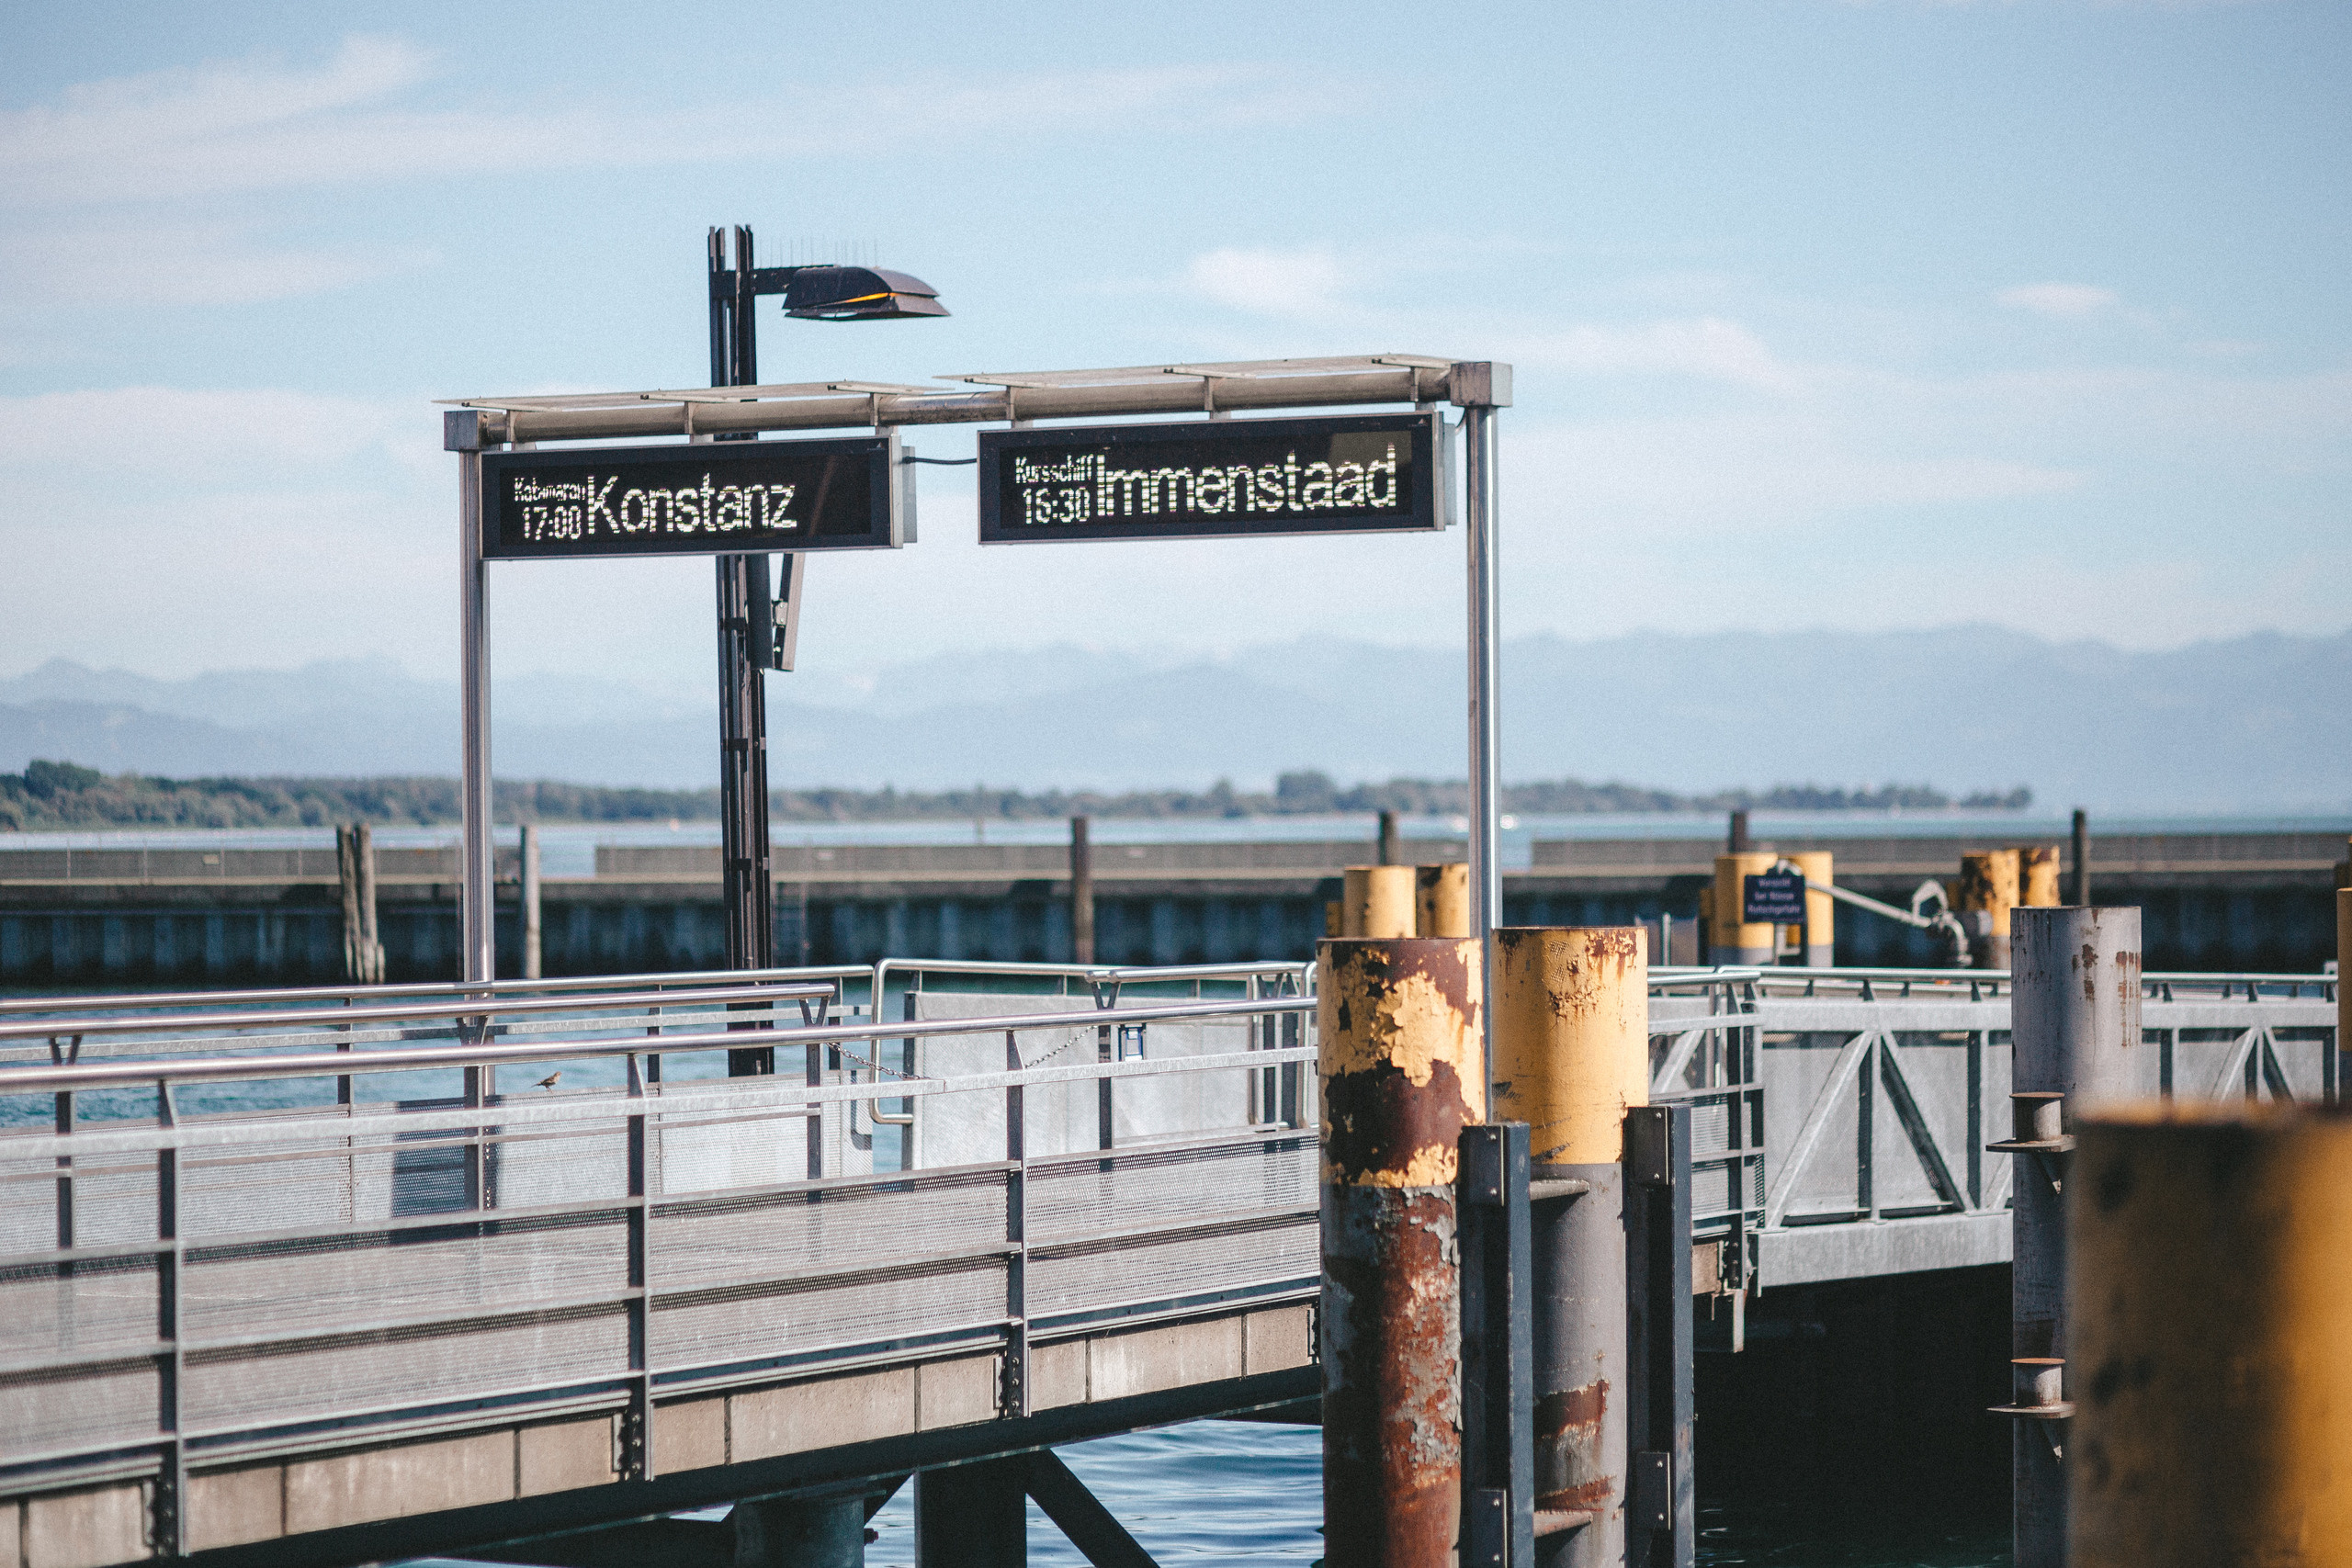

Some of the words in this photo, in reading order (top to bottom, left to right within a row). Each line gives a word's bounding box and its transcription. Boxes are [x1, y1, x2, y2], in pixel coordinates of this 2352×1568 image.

[1015, 454, 1094, 484] Kursschiff
[1096, 442, 1396, 516] Immenstaad
[522, 504, 582, 541] 17:00
[587, 472, 797, 534] Konstanz
[1023, 486, 1091, 525] 16:30
